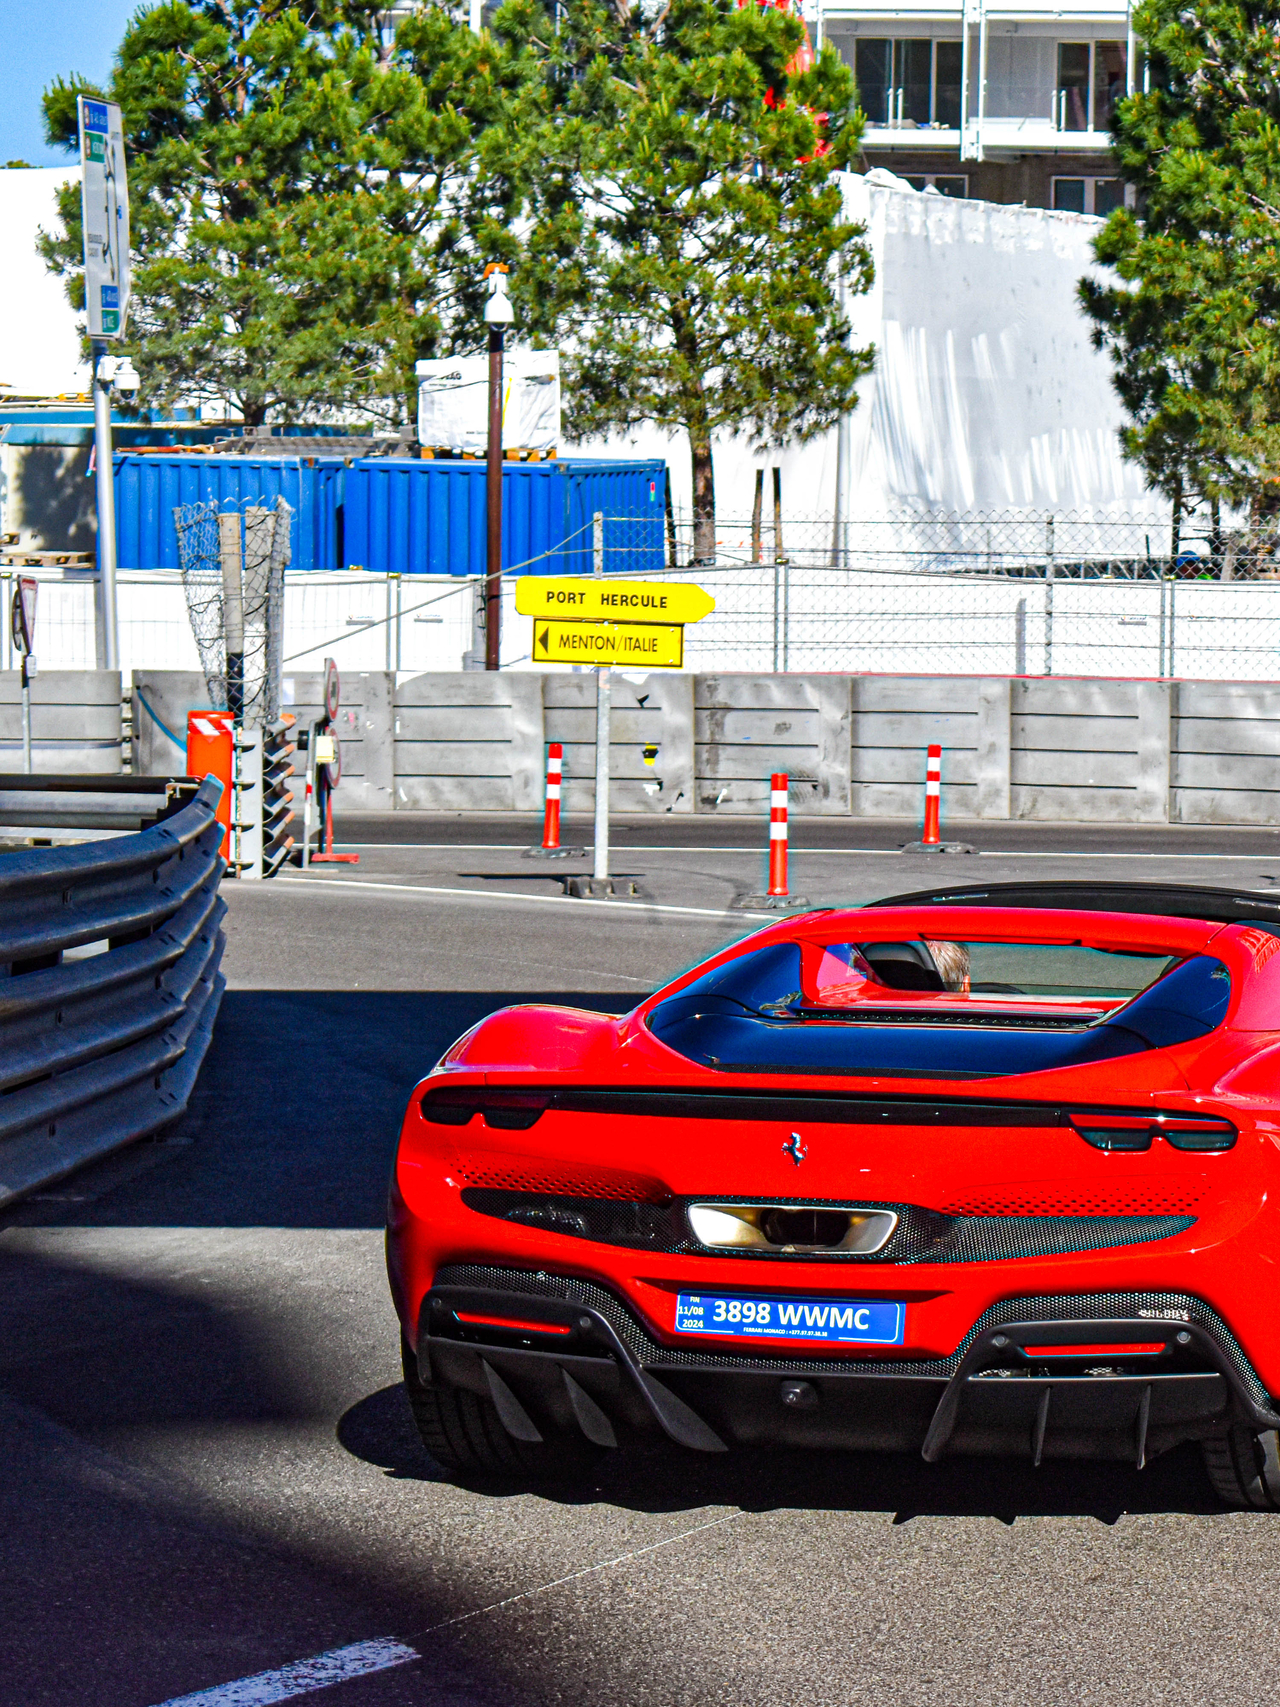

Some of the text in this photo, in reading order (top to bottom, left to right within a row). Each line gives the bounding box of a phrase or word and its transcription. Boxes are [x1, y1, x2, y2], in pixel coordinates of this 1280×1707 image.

[546, 591, 668, 609] PORT HERCULE
[559, 634, 658, 653] MENTON/ITALIE
[679, 1305, 704, 1316] 11/08
[713, 1300, 870, 1330] 3898 WWMC
[682, 1319, 704, 1329] 2024
